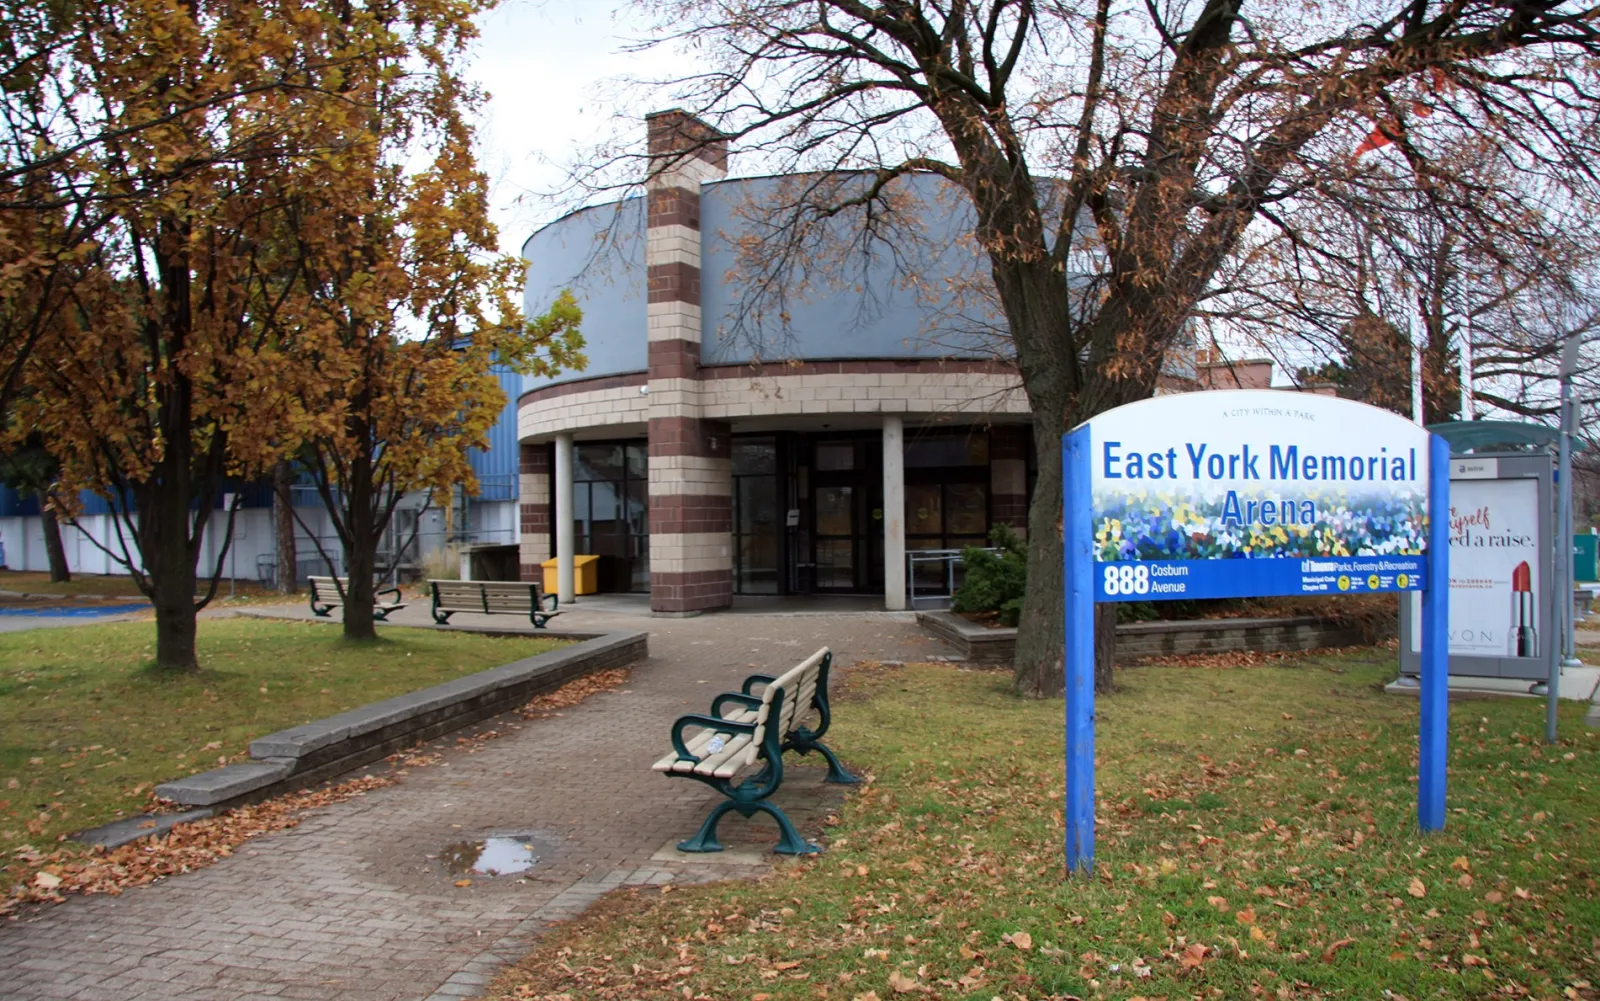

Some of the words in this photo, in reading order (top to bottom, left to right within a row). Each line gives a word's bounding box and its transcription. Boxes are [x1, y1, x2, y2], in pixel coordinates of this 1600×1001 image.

[1222, 410, 1229, 419] A
[1231, 408, 1249, 417] CITY
[1252, 407, 1282, 417] WITHIN
[1285, 409, 1292, 417] A
[1294, 410, 1316, 422] PARK
[1102, 441, 1177, 480] East
[1185, 442, 1260, 481] York
[1269, 444, 1416, 482] Memorial
[1220, 489, 1316, 526] Arena
[1449, 529, 1470, 548] ed
[1474, 535, 1485, 548] a
[1488, 528, 1536, 548] raise.
[1150, 563, 1189, 577] Cosburn
[1335, 562, 1353, 573] Parks,
[1353, 561, 1379, 572] Forestry
[1384, 560, 1418, 572] Recreation
[1104, 564, 1150, 596] 888
[1150, 580, 1186, 593] Avenue
[1449, 629, 1493, 643] VON
